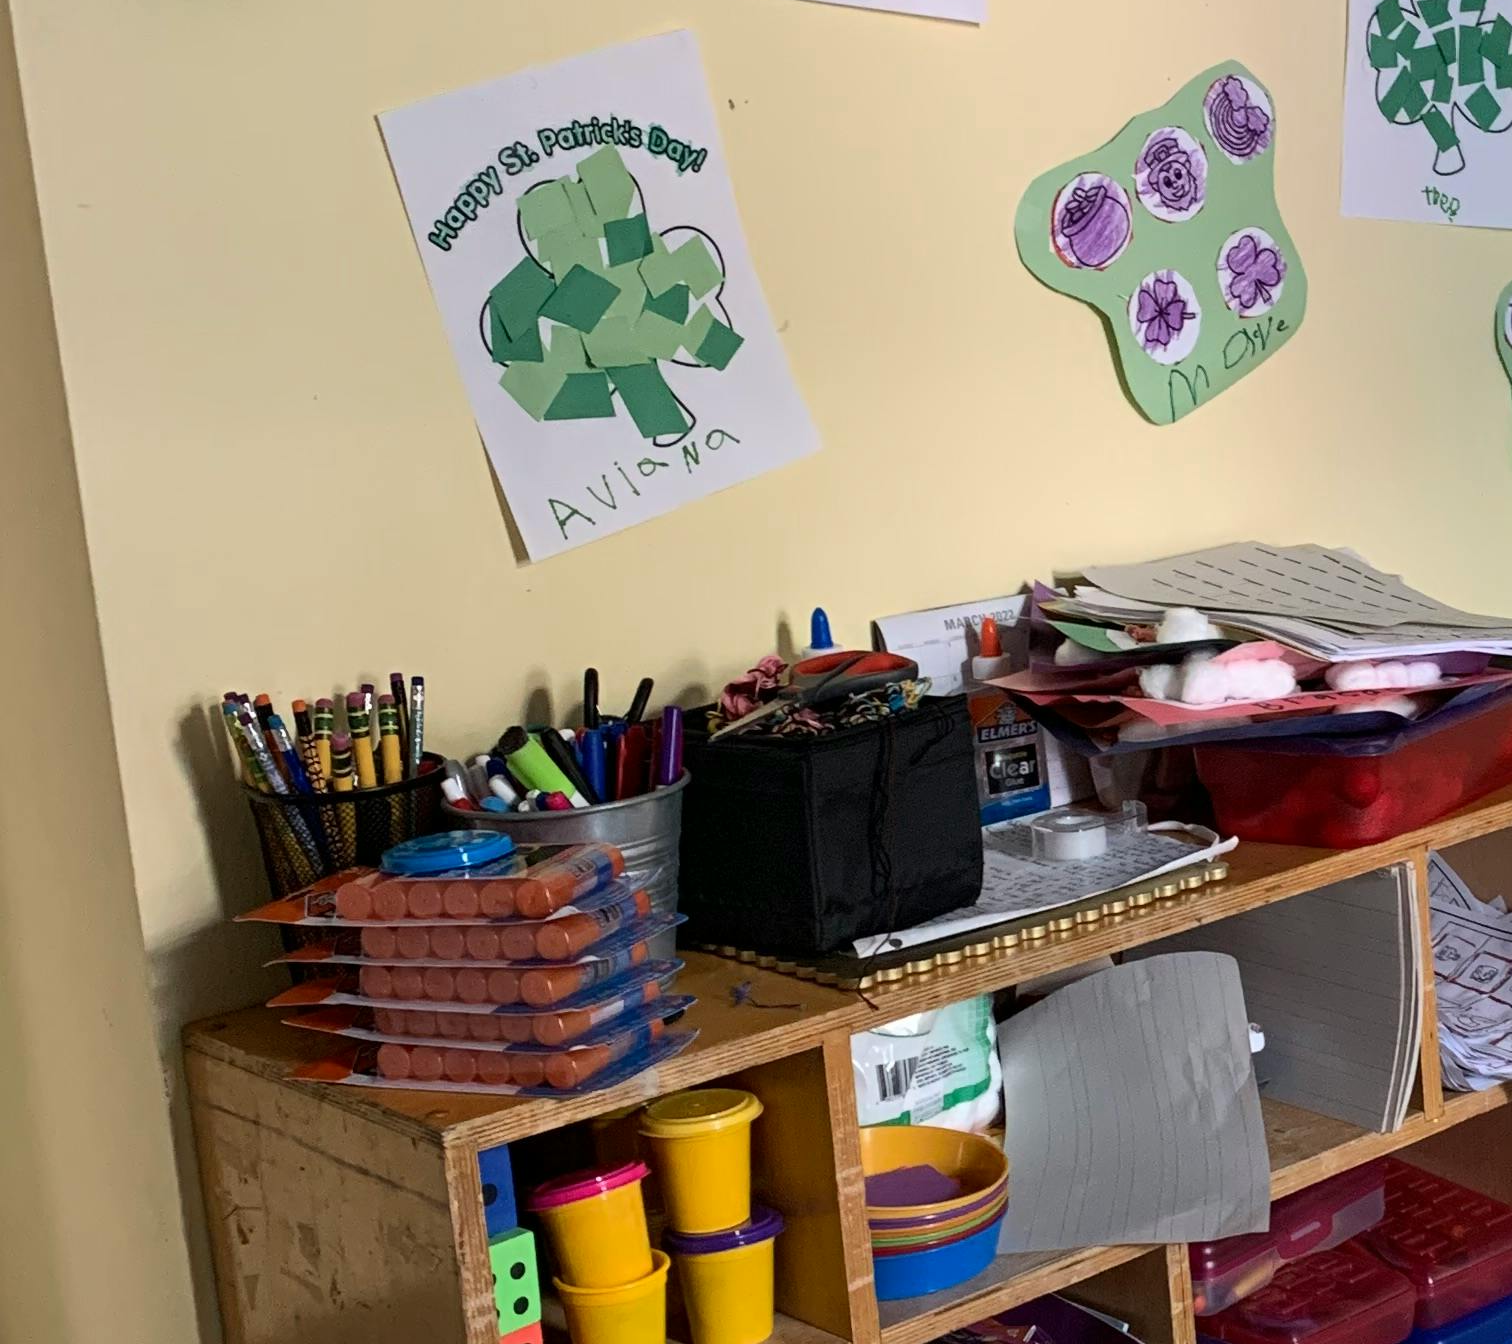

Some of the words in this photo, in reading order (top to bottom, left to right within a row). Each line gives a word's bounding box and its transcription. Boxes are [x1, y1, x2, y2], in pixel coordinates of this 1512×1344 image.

[428, 166, 504, 252] Happy
[499, 139, 540, 176] St.
[538, 116, 642, 154] Patrick's
[647, 126, 708, 174] Day!
[943, 614, 986, 632] MARCH
[979, 720, 1039, 742] ELMER'S
[989, 758, 1037, 780] Clear
